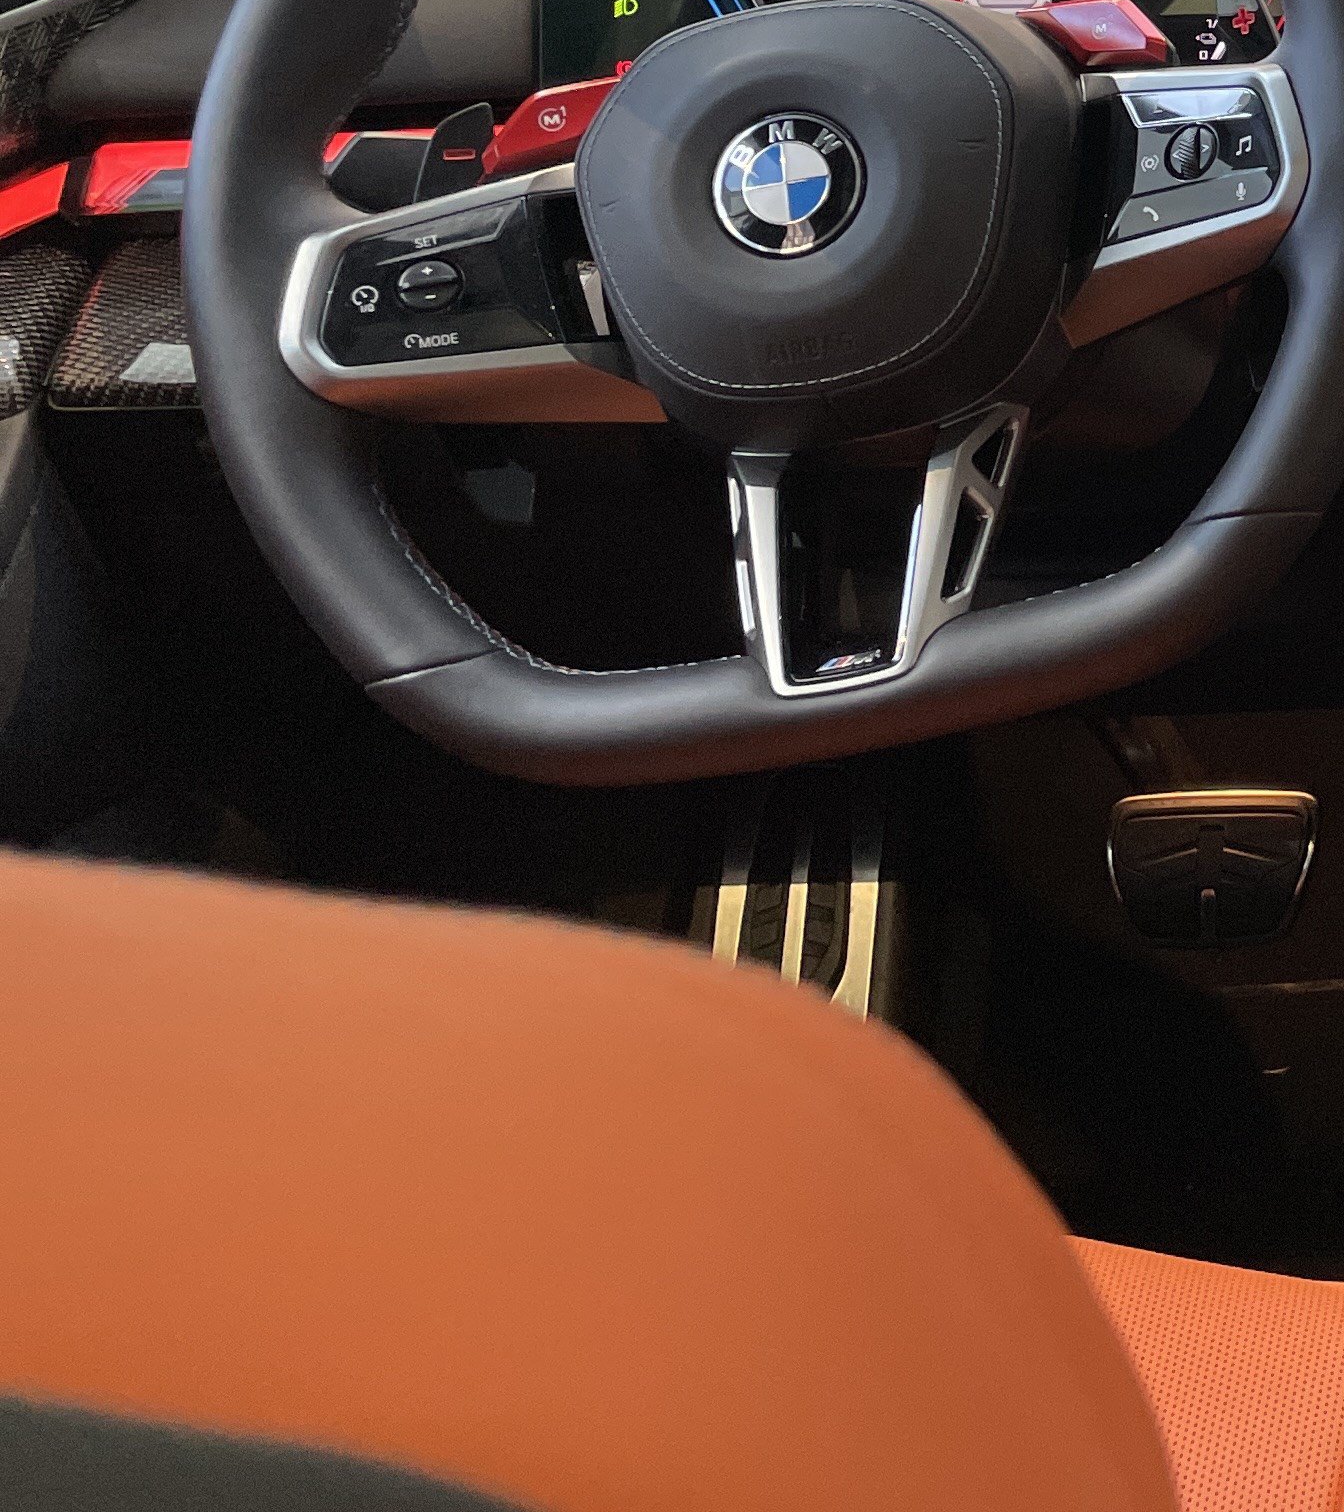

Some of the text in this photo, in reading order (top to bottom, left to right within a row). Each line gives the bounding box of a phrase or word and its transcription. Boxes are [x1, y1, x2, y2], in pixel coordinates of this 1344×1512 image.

[728, 120, 844, 170] BMW
[414, 235, 437, 249] SET
[419, 332, 460, 349] MODE
